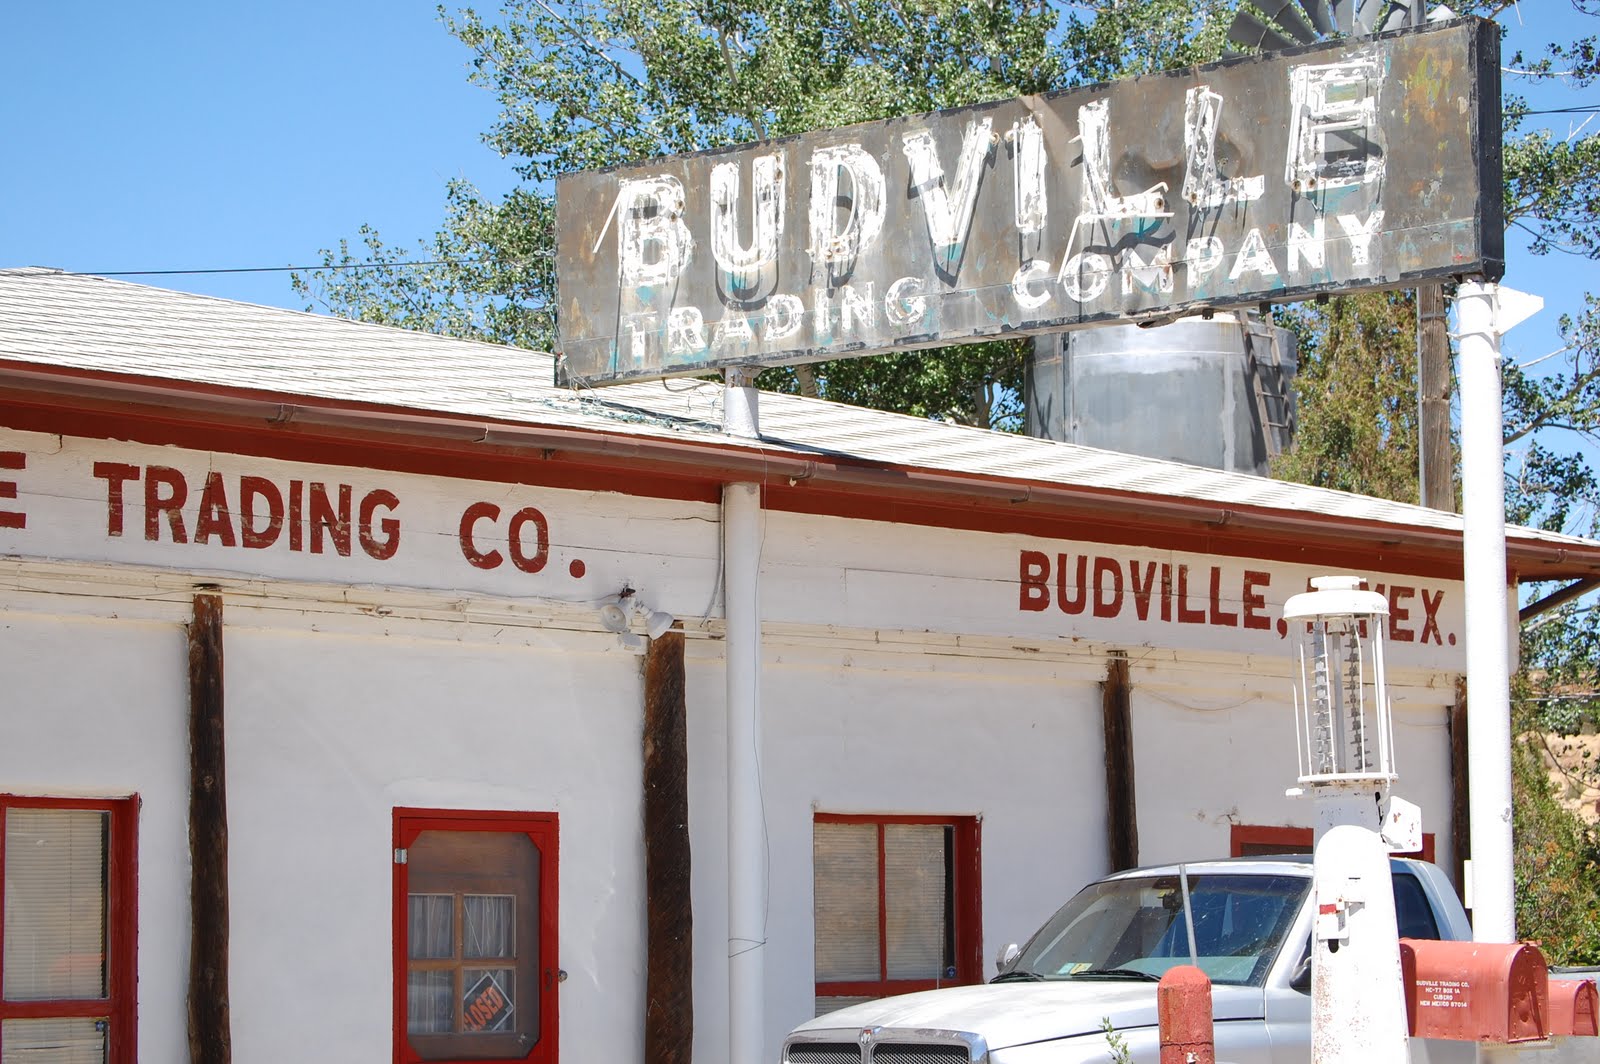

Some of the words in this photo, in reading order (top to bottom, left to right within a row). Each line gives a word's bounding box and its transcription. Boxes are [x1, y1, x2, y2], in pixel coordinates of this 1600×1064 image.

[616, 50, 1388, 290] BUDVILLE
[620, 276, 928, 358] TRADING
[1012, 210, 1386, 310] COMPANY
[93, 461, 400, 561] TRADING
[459, 501, 586, 579] CO.
[1019, 549, 1289, 640] BUDVILLE,
